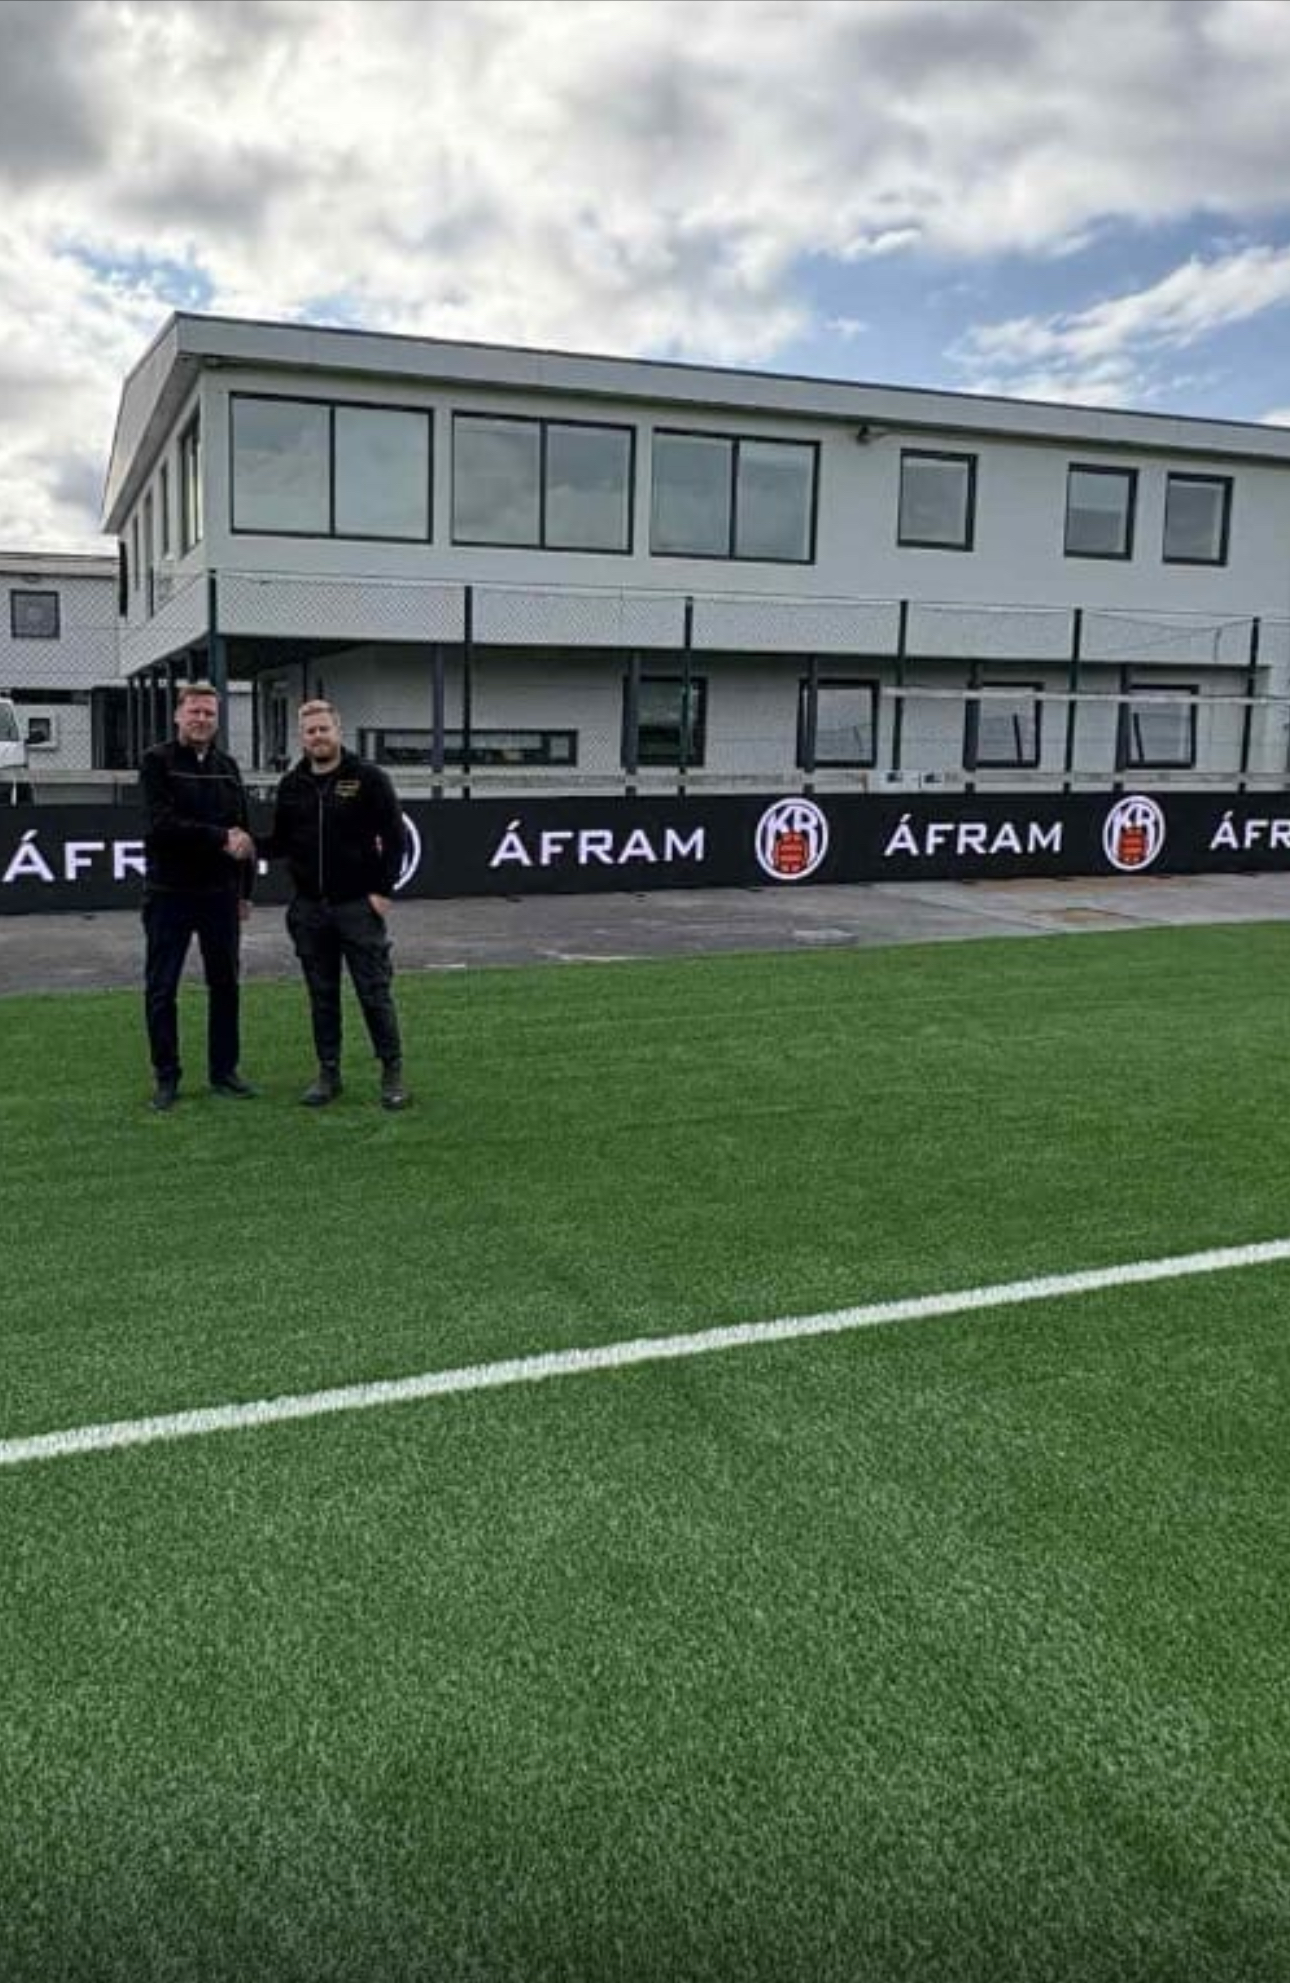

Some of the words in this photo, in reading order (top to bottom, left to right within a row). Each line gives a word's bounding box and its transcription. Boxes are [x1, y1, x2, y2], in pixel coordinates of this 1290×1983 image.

[489, 820, 705, 868] ÁFRAM
[765, 804, 820, 868] KR
[884, 813, 1063, 857] ÁFRAM
[1111, 802, 1157, 861] KR
